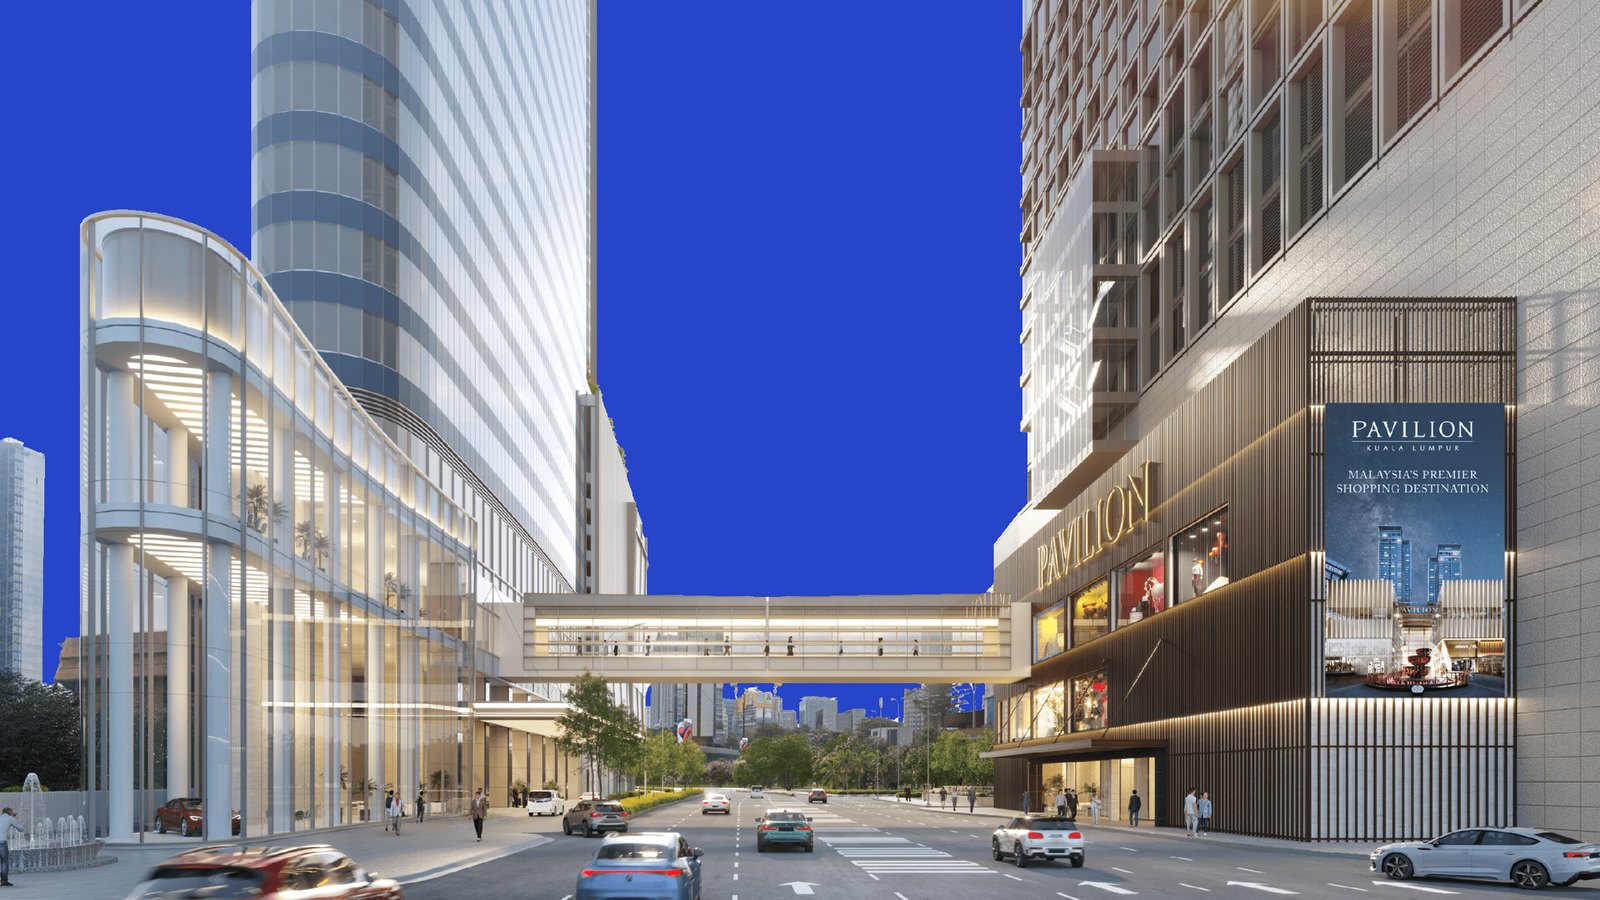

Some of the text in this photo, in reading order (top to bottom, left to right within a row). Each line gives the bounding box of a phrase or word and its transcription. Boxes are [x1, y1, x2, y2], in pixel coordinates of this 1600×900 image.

[1352, 420, 1474, 438] PAVILION
[1348, 469, 1478, 480] MALAYSIA'S PREMIER
[1336, 483, 1489, 494] SHOPPING DESTINATION
[1036, 461, 1149, 592] PAVILION
